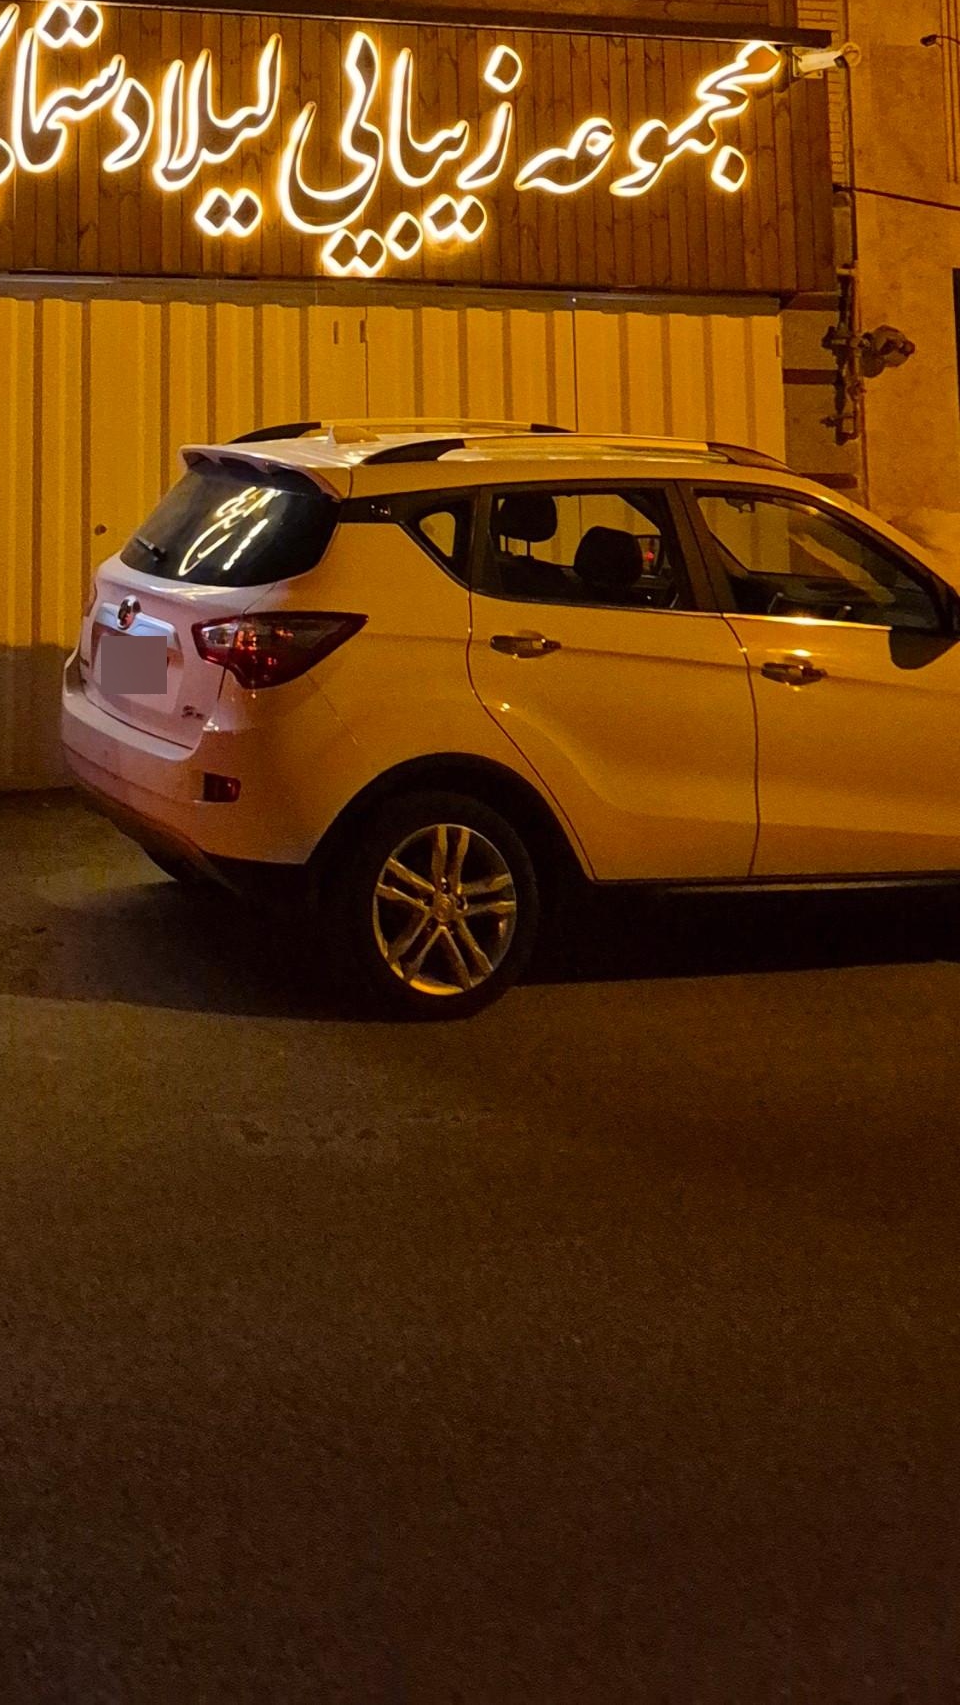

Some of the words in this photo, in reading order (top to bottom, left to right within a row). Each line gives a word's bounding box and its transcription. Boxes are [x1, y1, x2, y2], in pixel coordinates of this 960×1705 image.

[151, 32, 282, 239] لیلا
[276, 30, 523, 278] زیبایی
[514, 39, 782, 198] مجموعه
